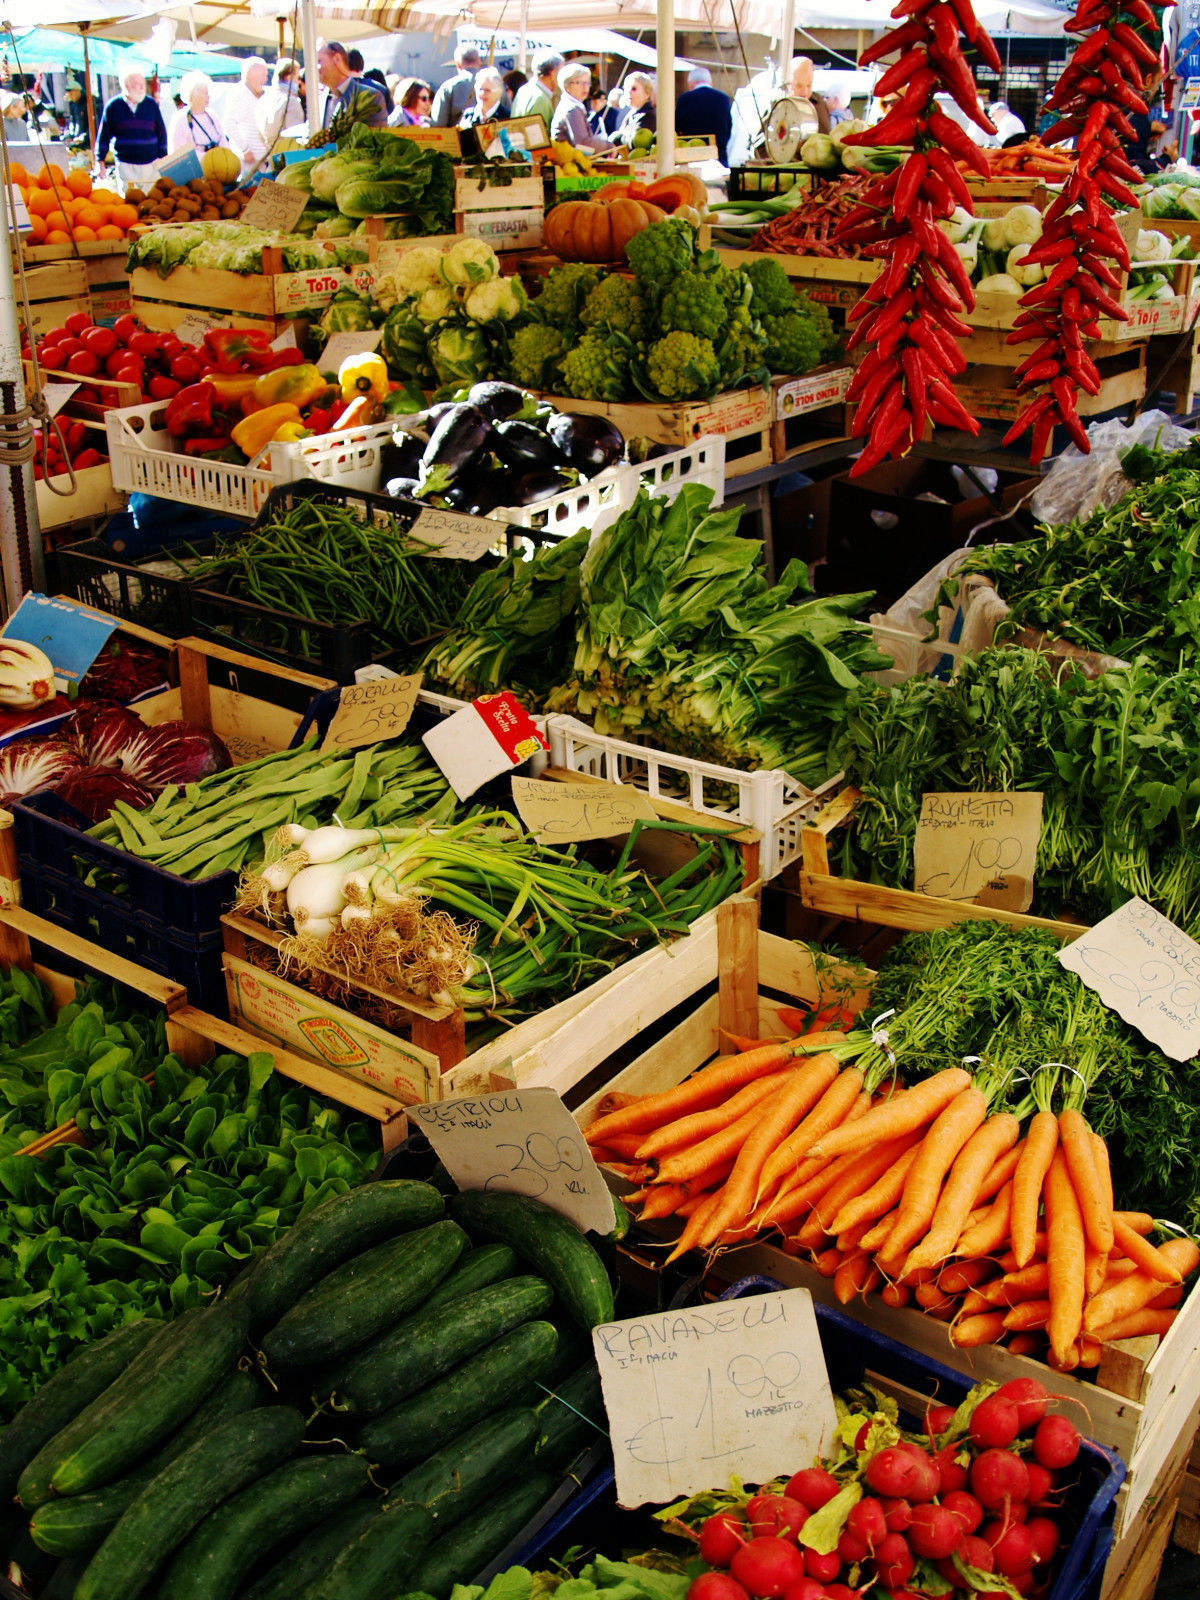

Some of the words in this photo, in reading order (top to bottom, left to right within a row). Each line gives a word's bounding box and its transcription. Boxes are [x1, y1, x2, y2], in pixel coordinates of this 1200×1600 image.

[478, 219, 528, 234] COFERASTA
[794, 393, 814, 408] SOLE
[498, 701, 518, 725] Frutta
[924, 795, 1014, 822] RUGHETTA
[417, 1096, 523, 1124] CETRIOLI
[596, 1295, 788, 1357] RAVANELLI
